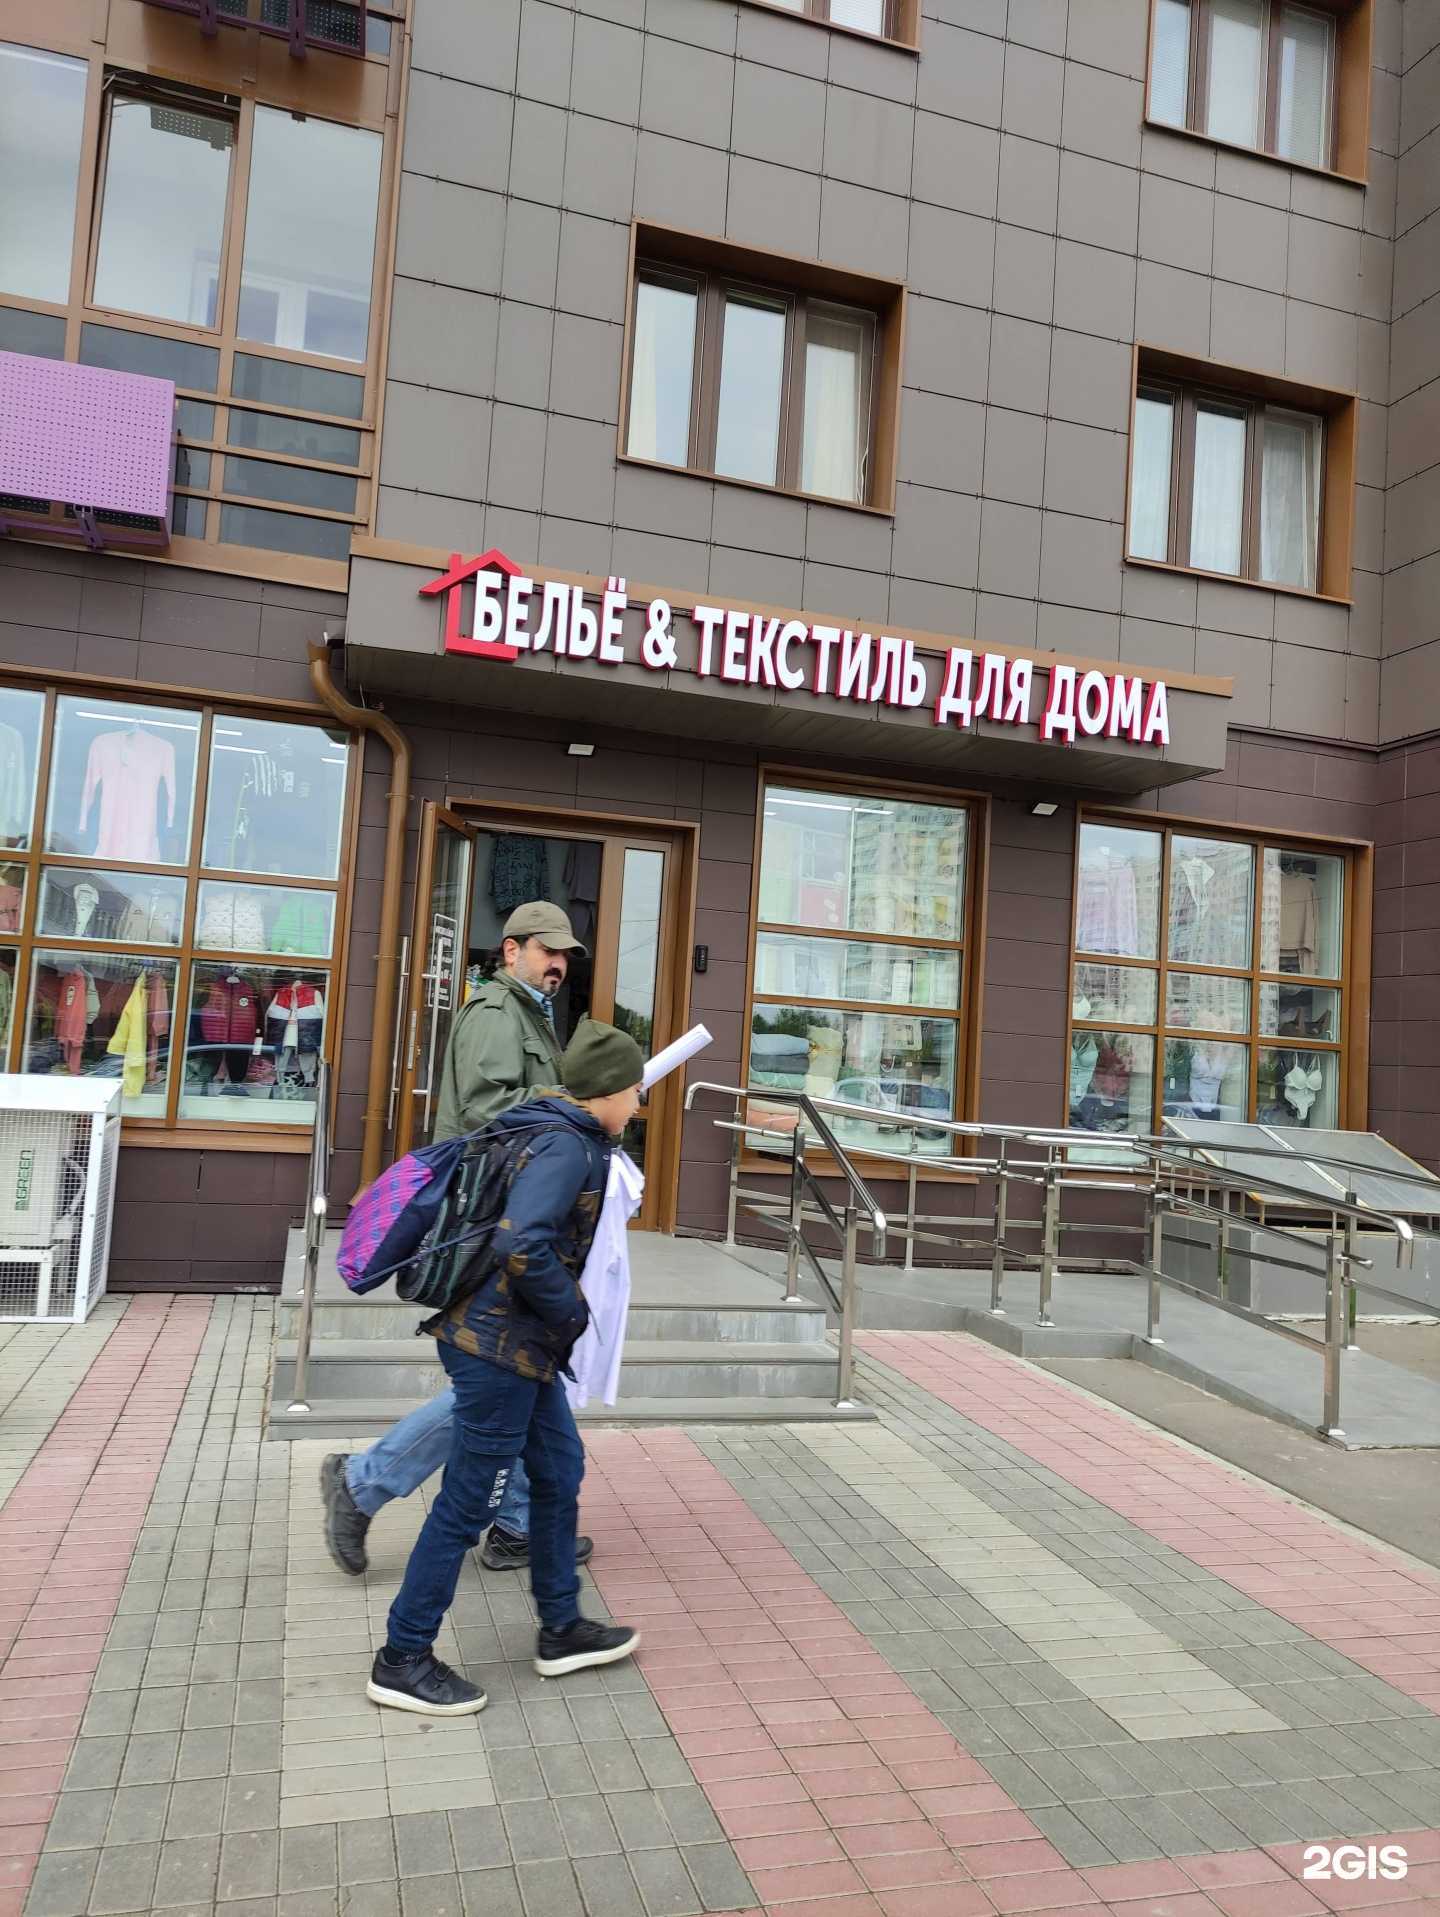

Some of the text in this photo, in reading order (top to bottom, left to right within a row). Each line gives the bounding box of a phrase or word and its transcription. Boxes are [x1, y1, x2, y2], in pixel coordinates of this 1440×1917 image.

[471, 570, 1171, 746] БЕЛЬЁ & ТЕКСТИЛЬ ДЛЯ ДОМА
